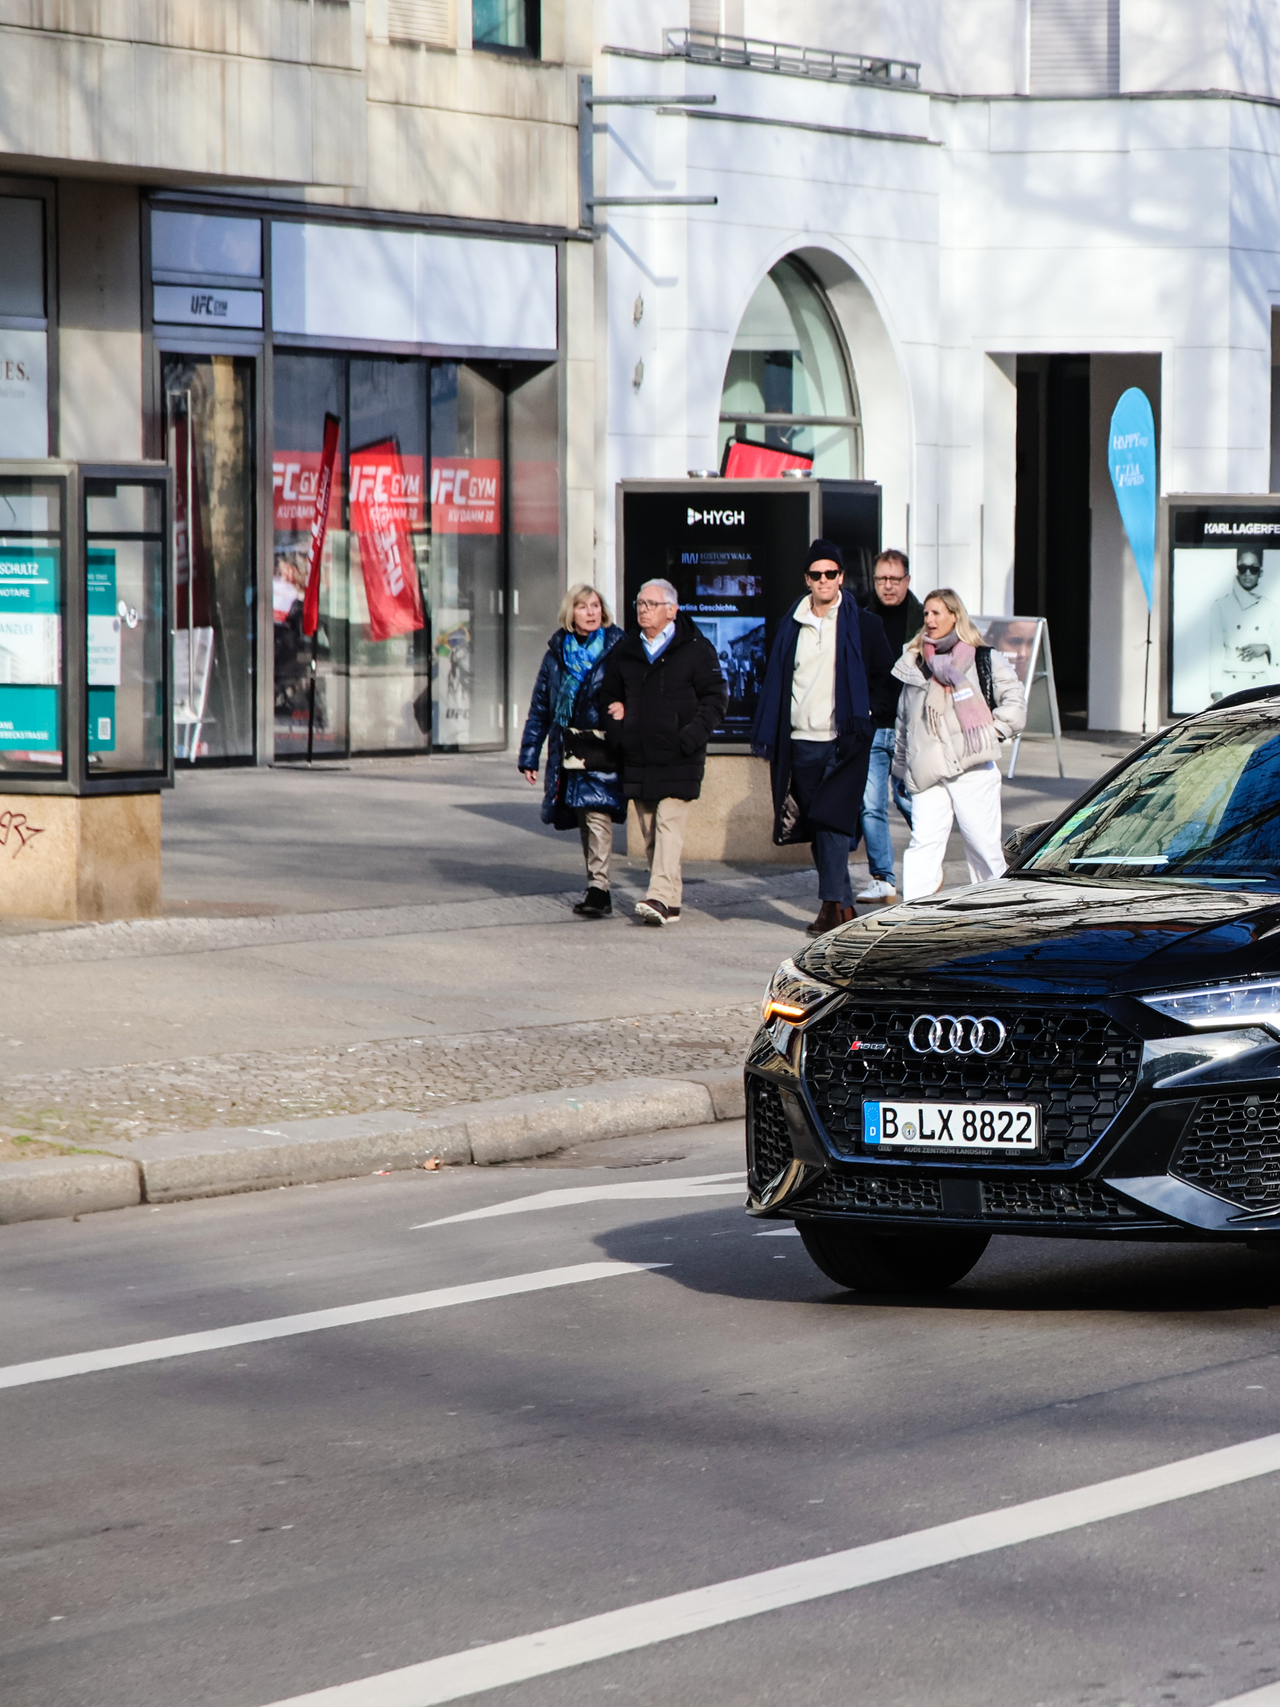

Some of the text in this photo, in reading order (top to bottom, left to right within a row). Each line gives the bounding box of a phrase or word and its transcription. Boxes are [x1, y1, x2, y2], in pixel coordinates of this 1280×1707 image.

[190, 295, 213, 315] UFC
[0, 360, 30, 381] ES.
[391, 475, 420, 495] GYM
[469, 477, 496, 498] GYM
[703, 510, 745, 525] HYGH
[1204, 523, 1232, 534] KARL
[700, 552, 752, 561] HISTORYWALK
[0, 562, 39, 576] SCHULTZ
[882, 1108, 899, 1138] B
[919, 1109, 954, 1141] LX
[962, 1110, 1032, 1143] 8822
[903, 1146, 993, 1155] AUDI ZENTRUM LANDSHUT
